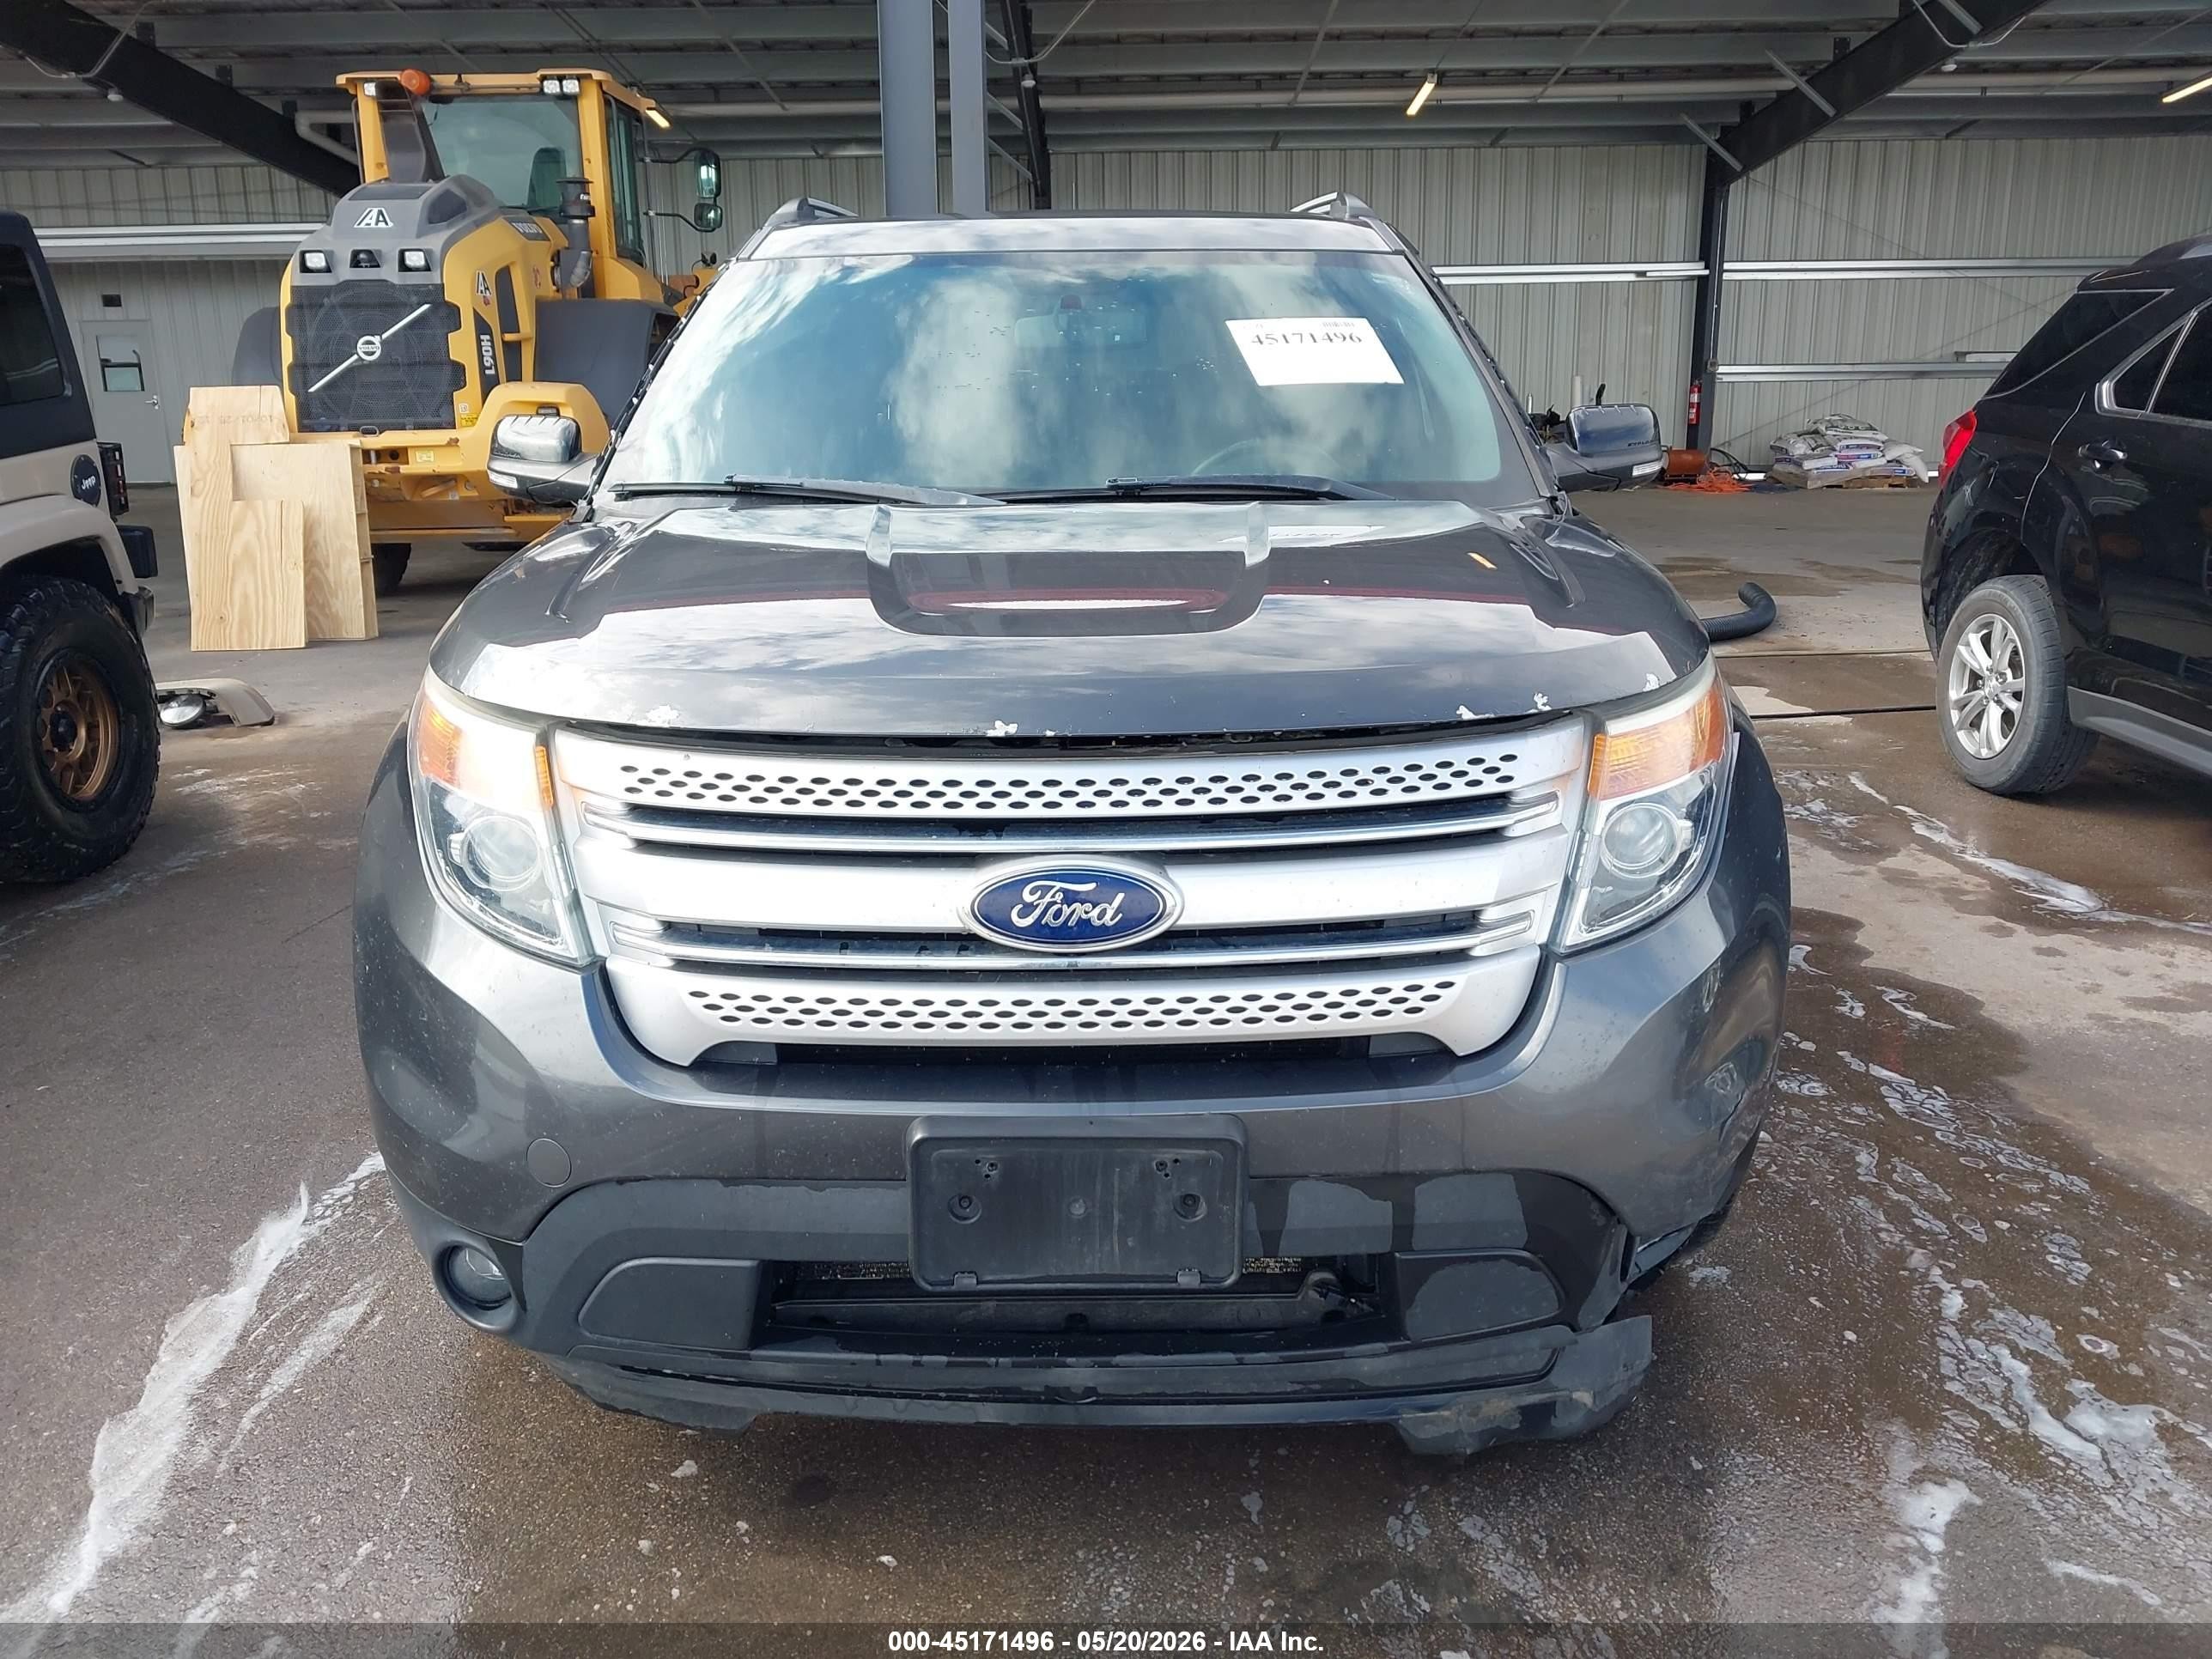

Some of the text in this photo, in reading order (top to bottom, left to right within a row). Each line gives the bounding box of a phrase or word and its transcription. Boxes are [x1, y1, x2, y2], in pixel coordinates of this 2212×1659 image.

[480, 334, 495, 374] L90H
[1251, 331, 1363, 345] 45171496
[1011, 880, 1125, 927] Ford
